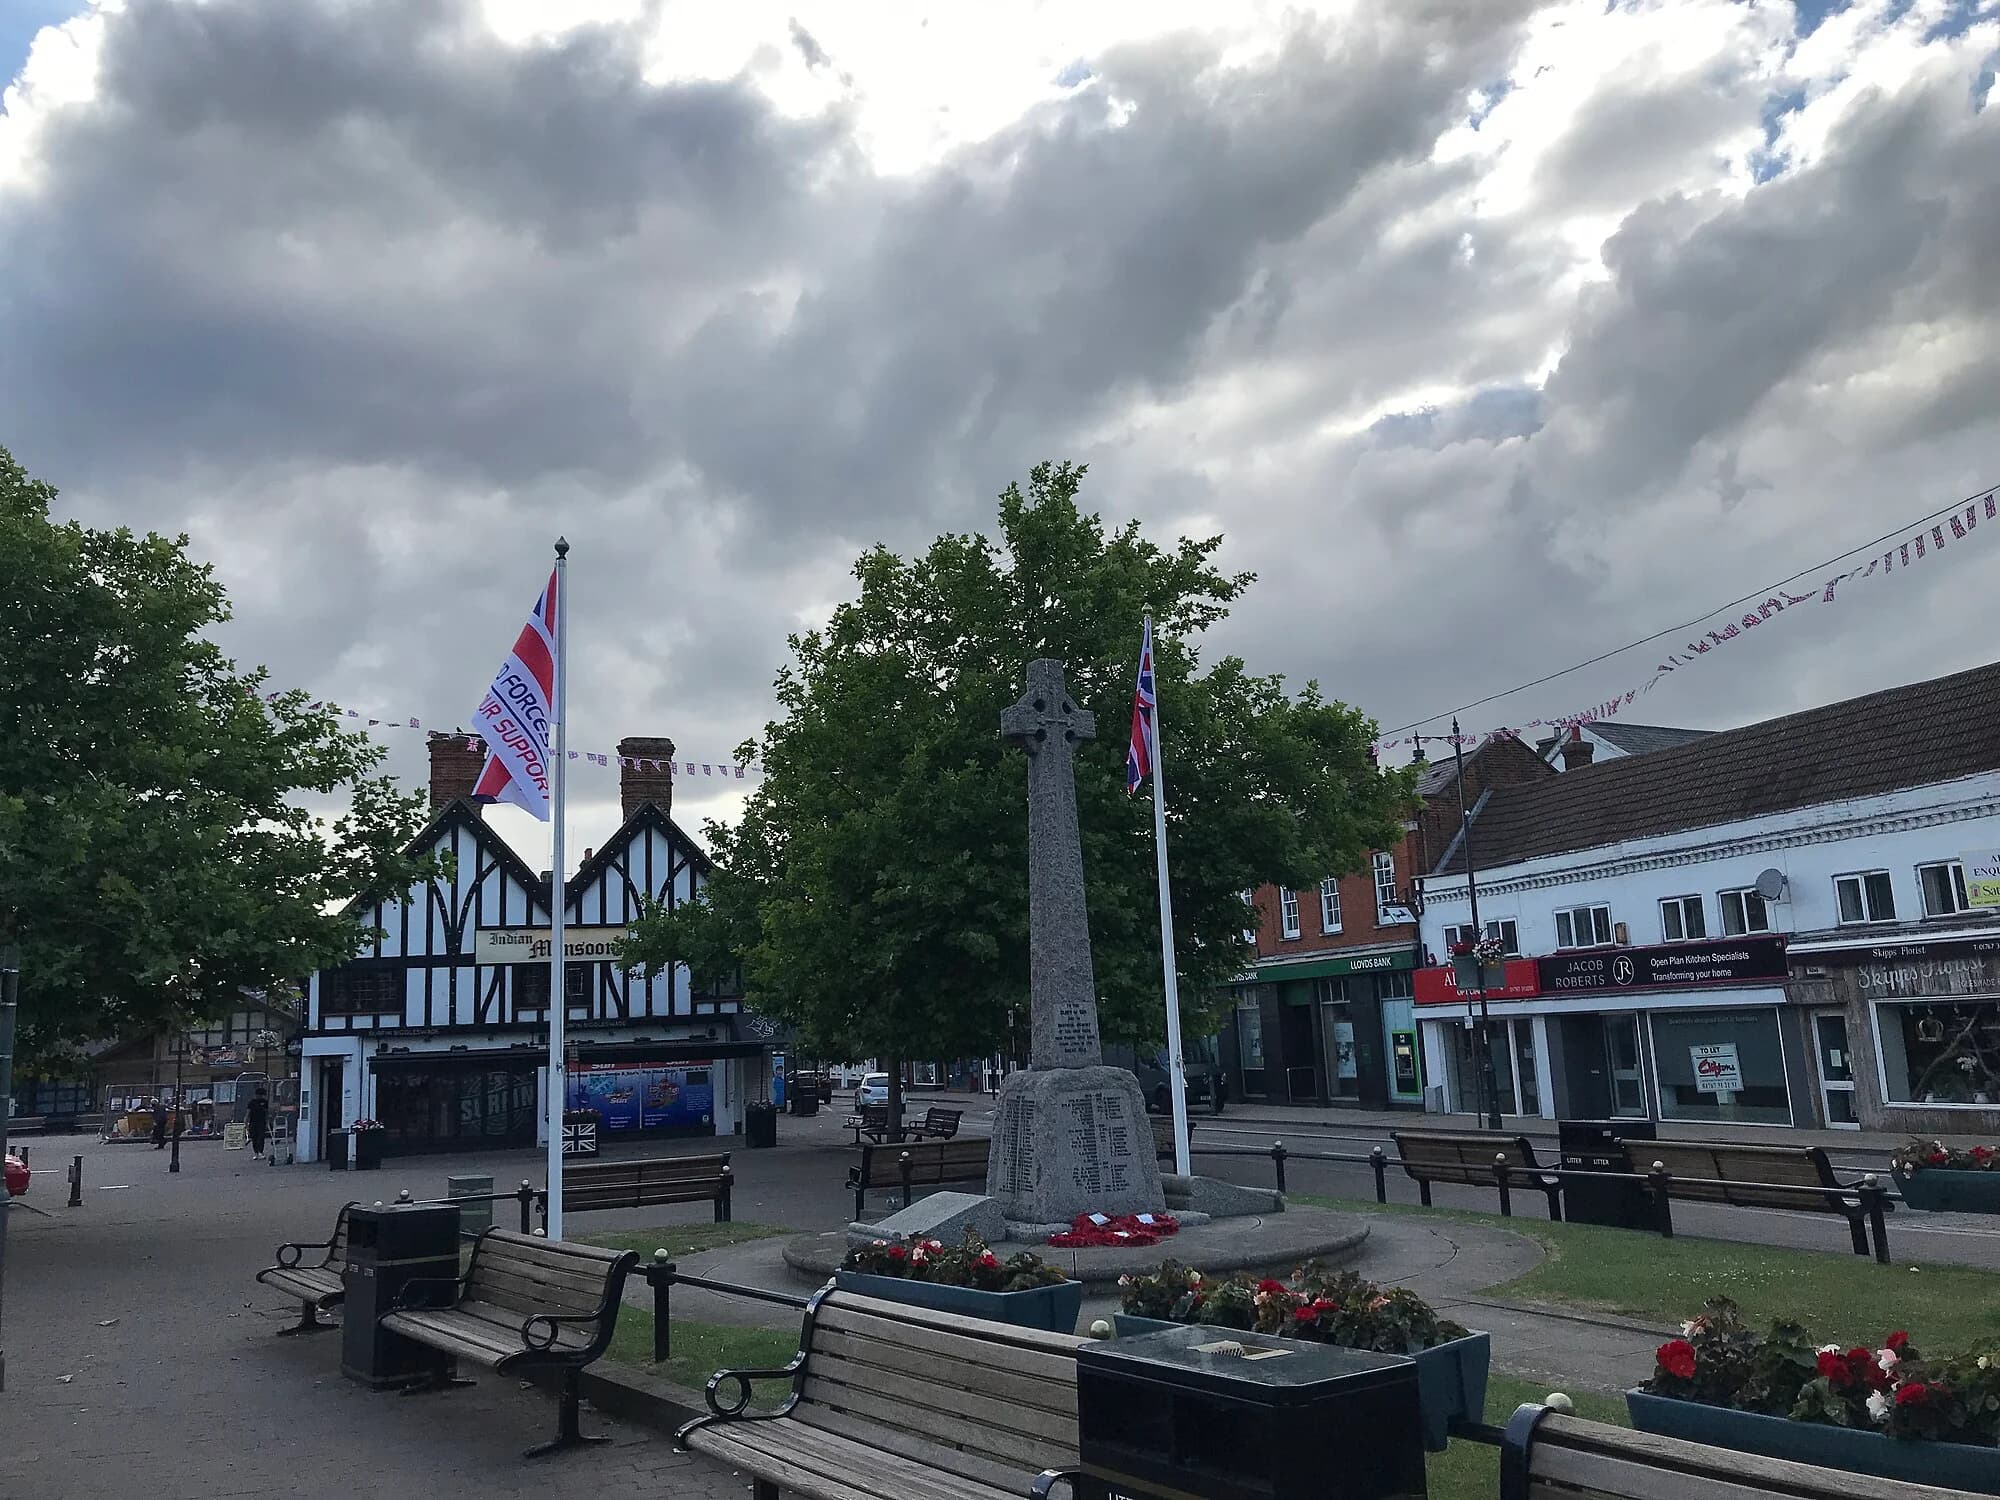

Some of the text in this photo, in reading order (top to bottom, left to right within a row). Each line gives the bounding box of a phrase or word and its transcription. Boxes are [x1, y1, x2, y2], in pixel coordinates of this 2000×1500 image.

[500, 674, 549, 748] FORCES
[489, 932, 533, 946] Indian
[528, 939, 620, 959] Mnsoon
[1872, 946, 1927, 959] Skipps Florist
[1350, 957, 1392, 970] LLOYDS BANK
[1567, 960, 1604, 972] JACOB
[1650, 951, 1750, 968] Open Plan Kitchen Specialists
[1555, 974, 1605, 988] ROBERTS
[1652, 969, 1732, 981] Transforming your home
[1709, 1046, 1721, 1054] LET
